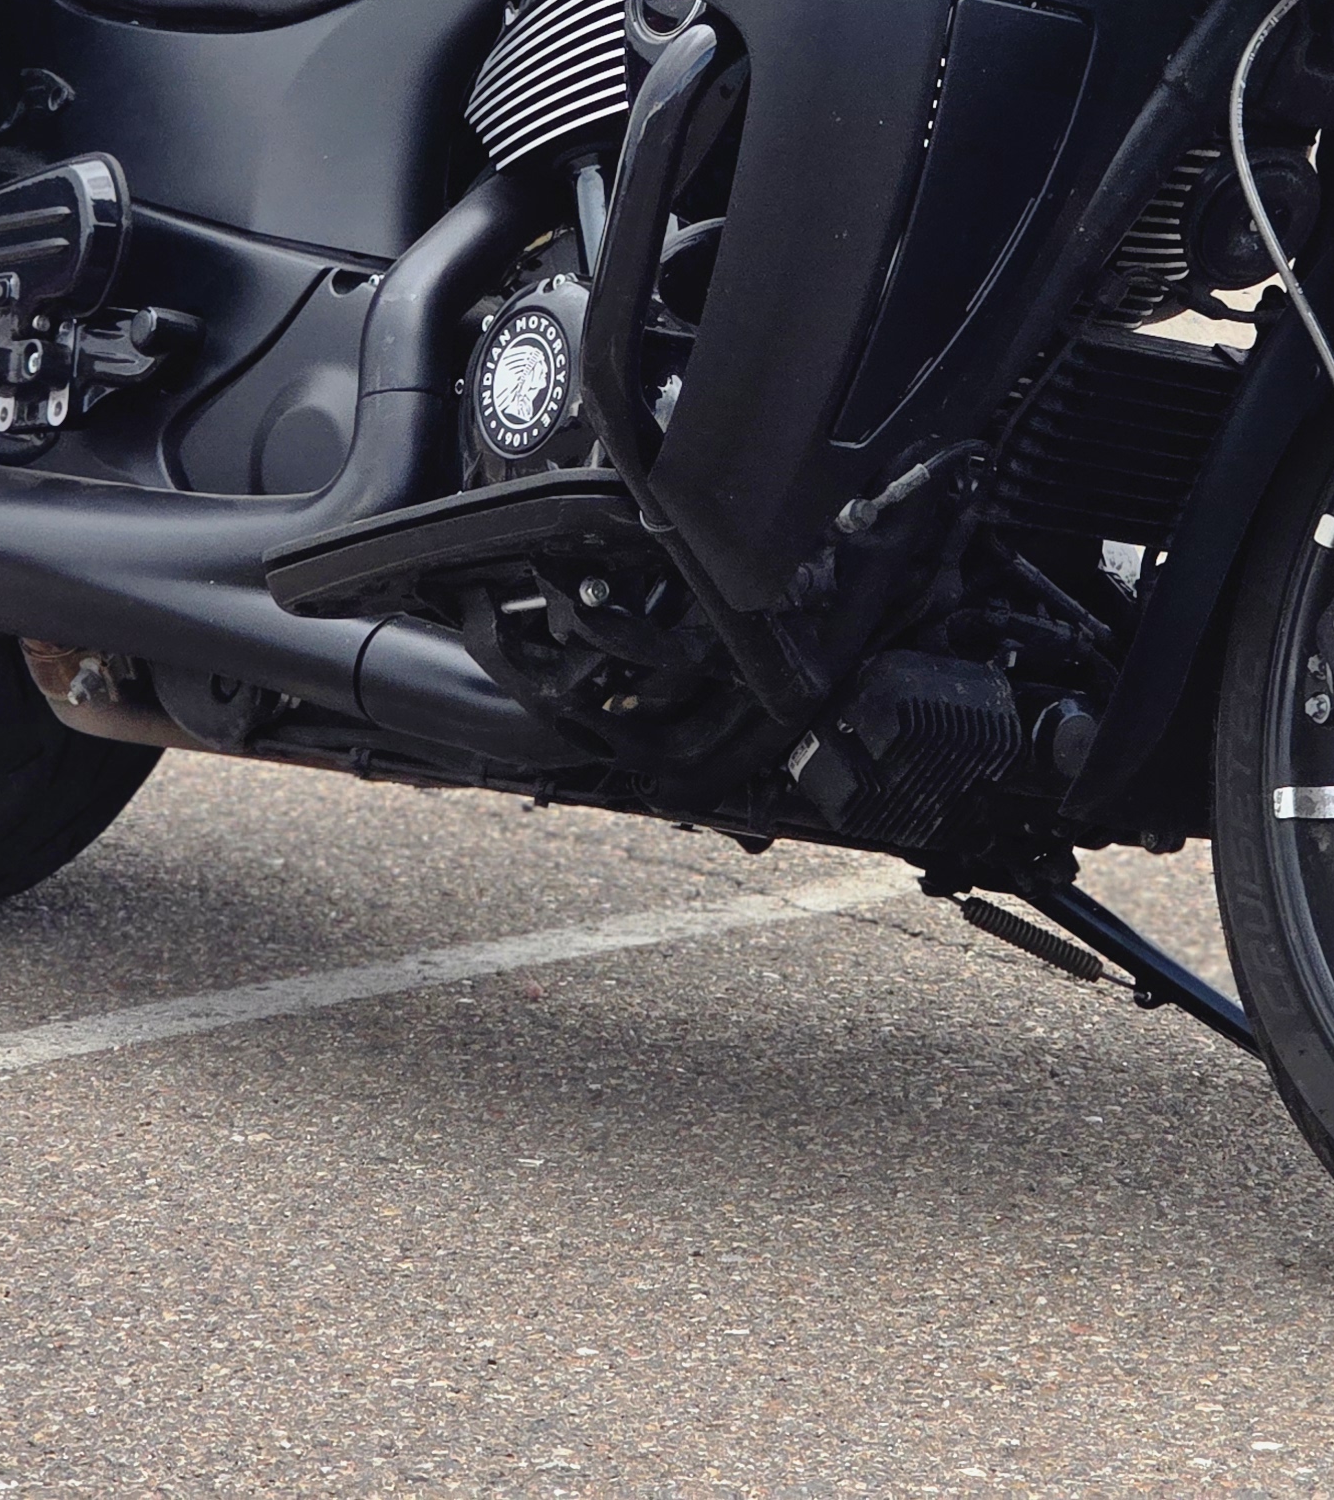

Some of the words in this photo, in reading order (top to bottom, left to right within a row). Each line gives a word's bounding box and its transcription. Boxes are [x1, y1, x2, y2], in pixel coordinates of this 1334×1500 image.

[482, 329, 512, 417] INDIAN
[515, 315, 567, 428] MOTORCYCLE
[497, 427, 529, 447] 1901
